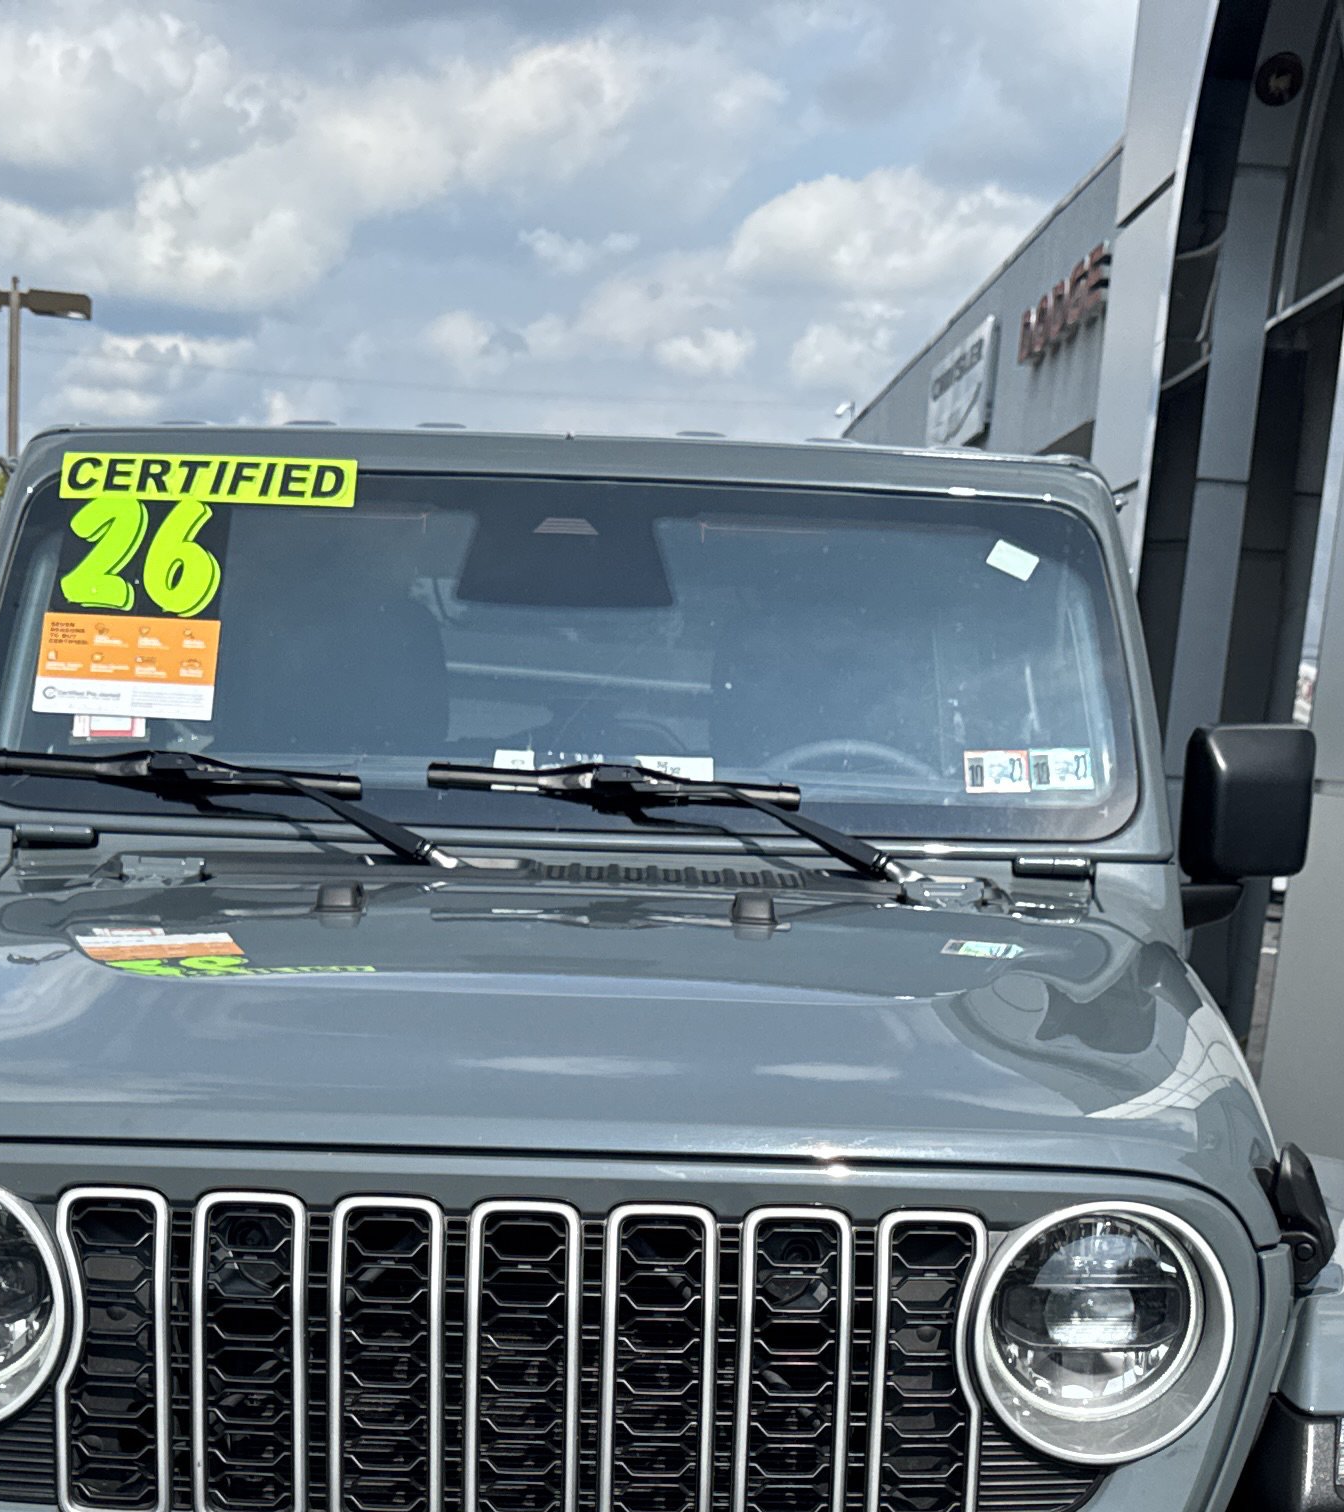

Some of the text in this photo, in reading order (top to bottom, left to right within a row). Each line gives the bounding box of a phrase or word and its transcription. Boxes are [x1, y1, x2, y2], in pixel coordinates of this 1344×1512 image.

[1017, 240, 1111, 363] DODGE
[67, 457, 345, 499] CERTIFIED
[60, 498, 221, 618] 26
